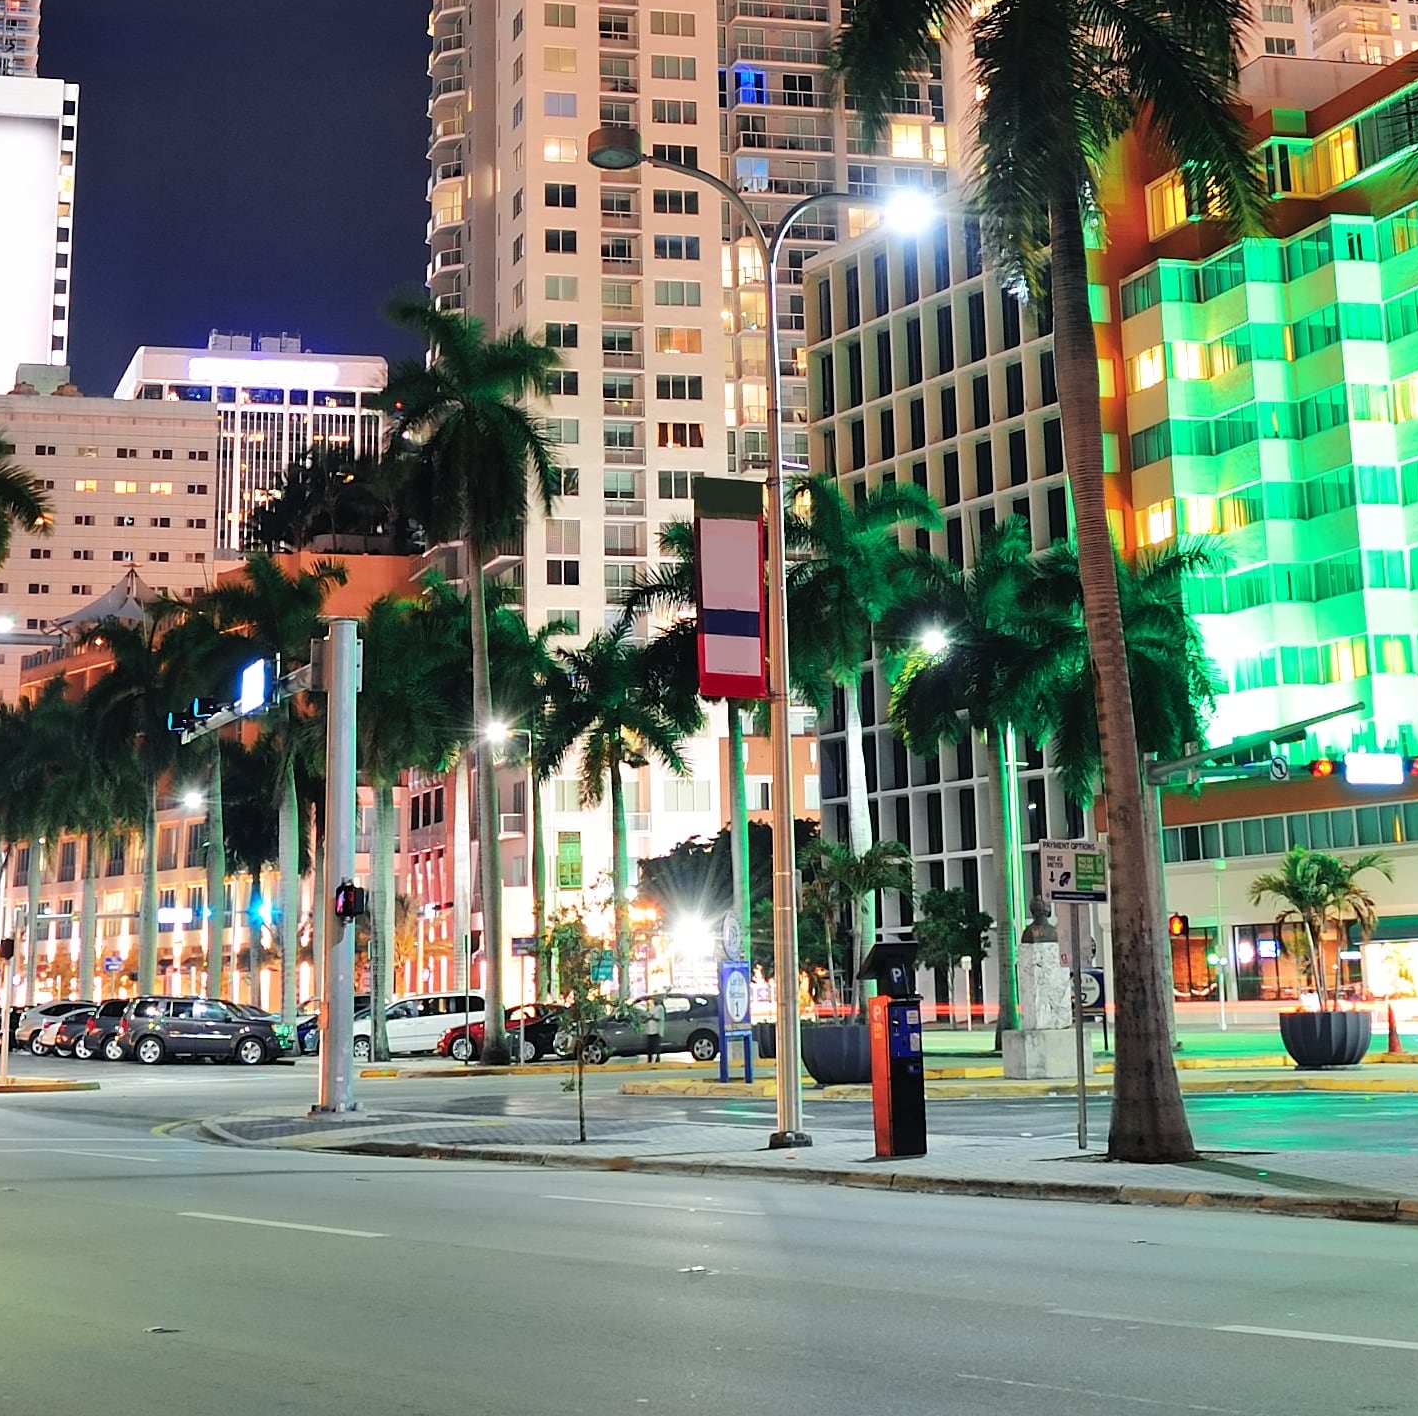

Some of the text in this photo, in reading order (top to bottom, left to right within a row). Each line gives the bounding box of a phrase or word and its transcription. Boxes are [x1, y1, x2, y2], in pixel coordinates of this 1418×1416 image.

[1043, 841, 1095, 851] PAYMENT OPTIONS
[891, 968, 902, 983] P
[735, 1000, 740, 1017] 1
[872, 1005, 882, 1021] P
